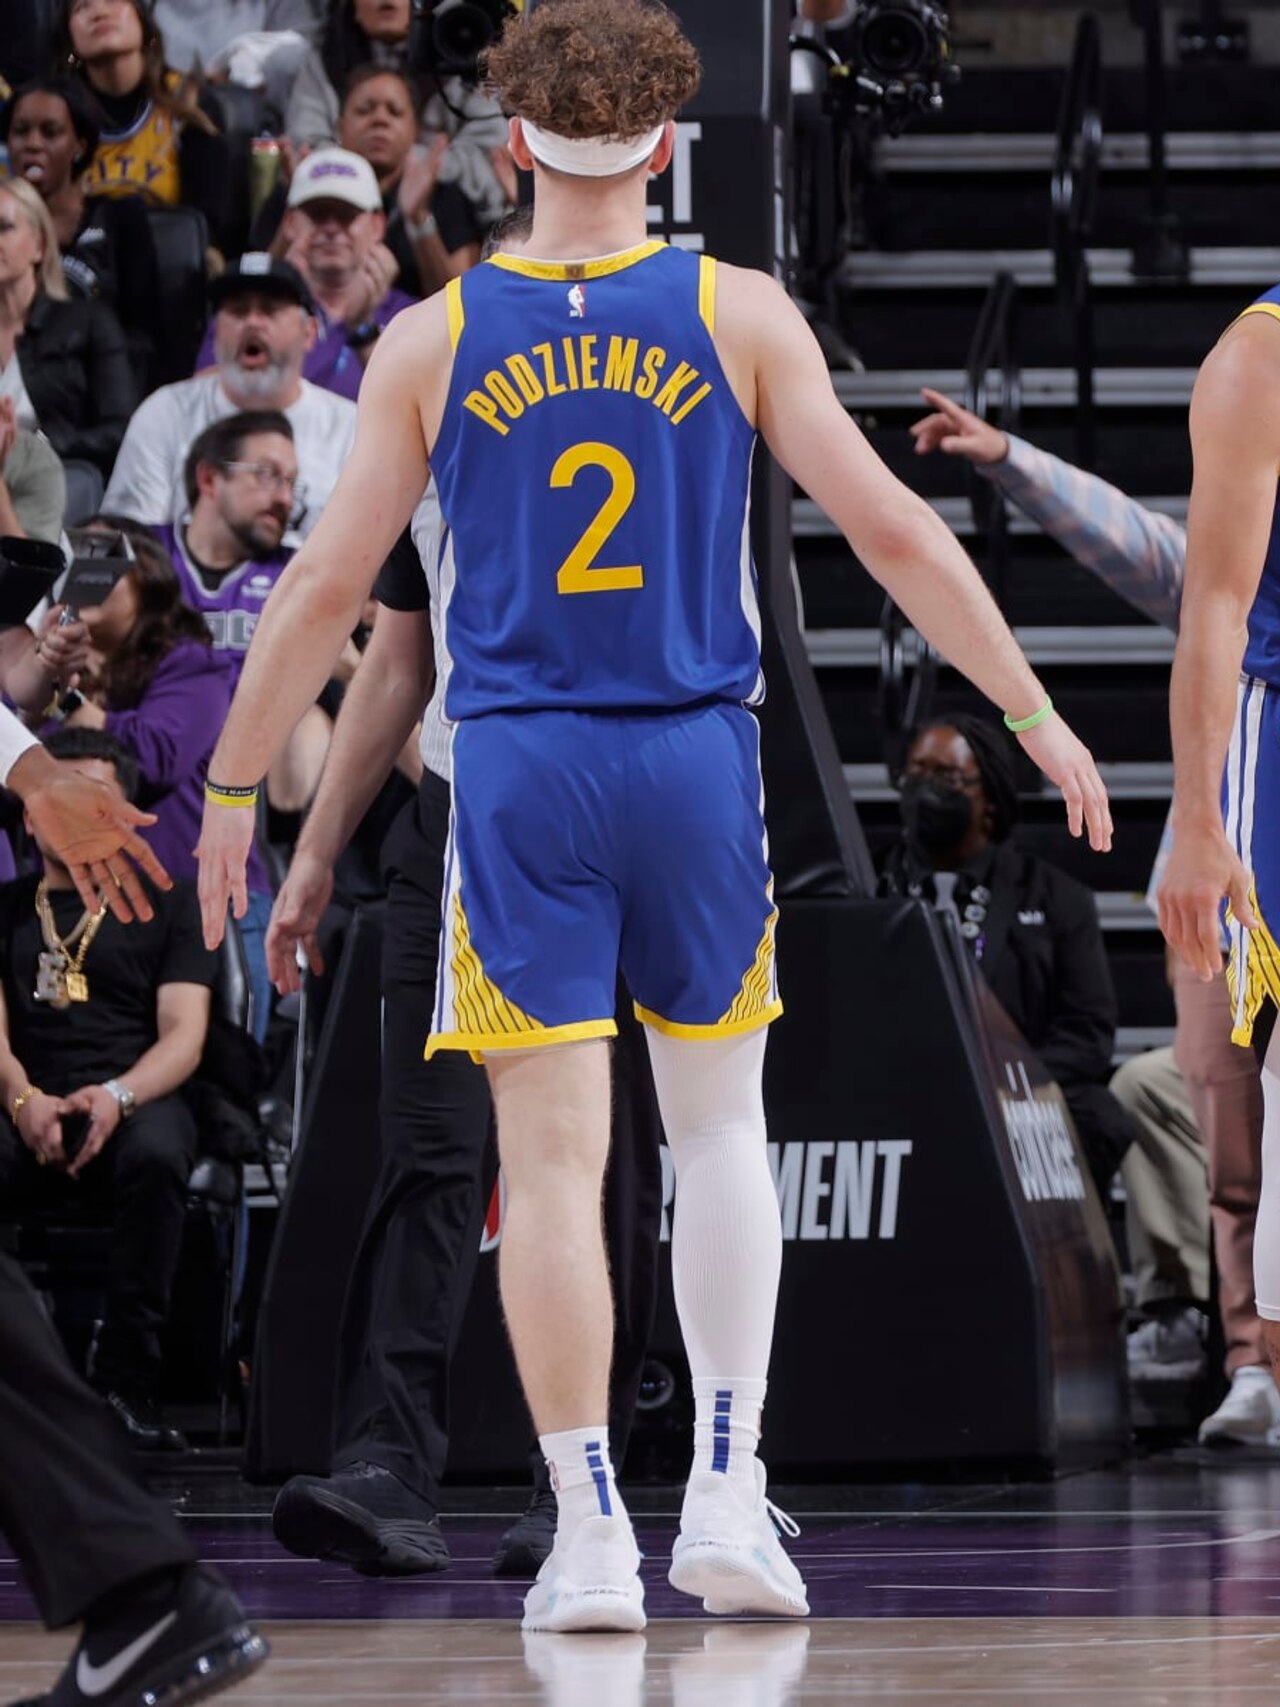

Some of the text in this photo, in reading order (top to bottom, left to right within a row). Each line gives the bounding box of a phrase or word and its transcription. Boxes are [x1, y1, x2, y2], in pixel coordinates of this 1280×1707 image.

[87, 155, 164, 183] ITY
[463, 334, 712, 436] PODZIEMSKI
[550, 441, 644, 594] 2
